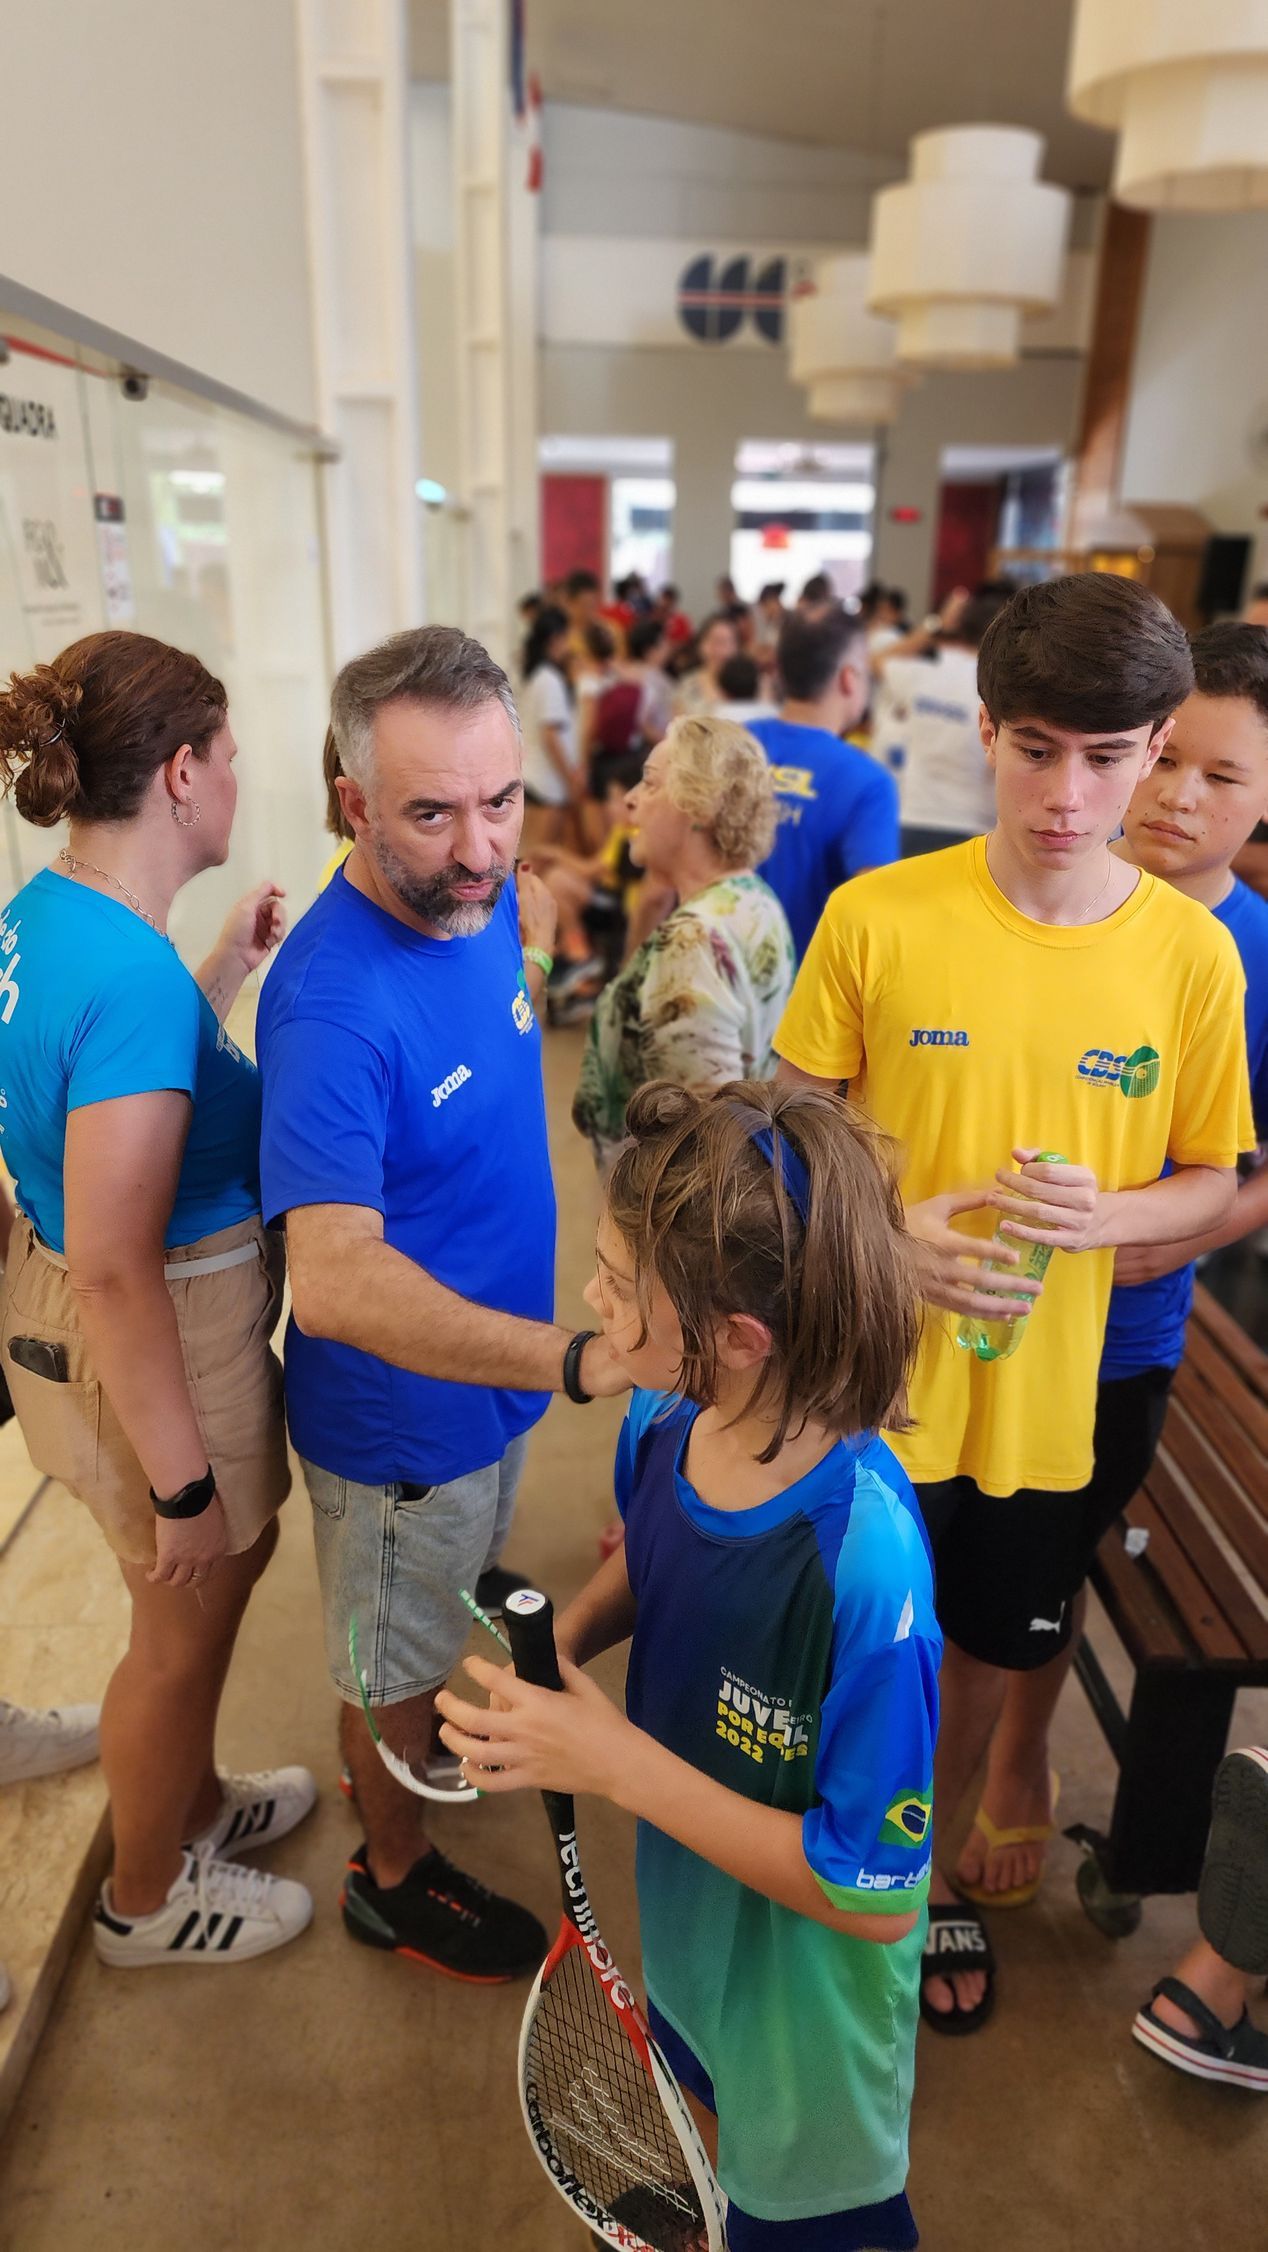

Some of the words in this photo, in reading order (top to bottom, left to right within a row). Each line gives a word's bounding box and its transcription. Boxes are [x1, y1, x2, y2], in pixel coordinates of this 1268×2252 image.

[720, 1665, 786, 1708] CAMPEONATO
[717, 1699, 754, 1736] POR
[715, 1720, 764, 1764] 2022
